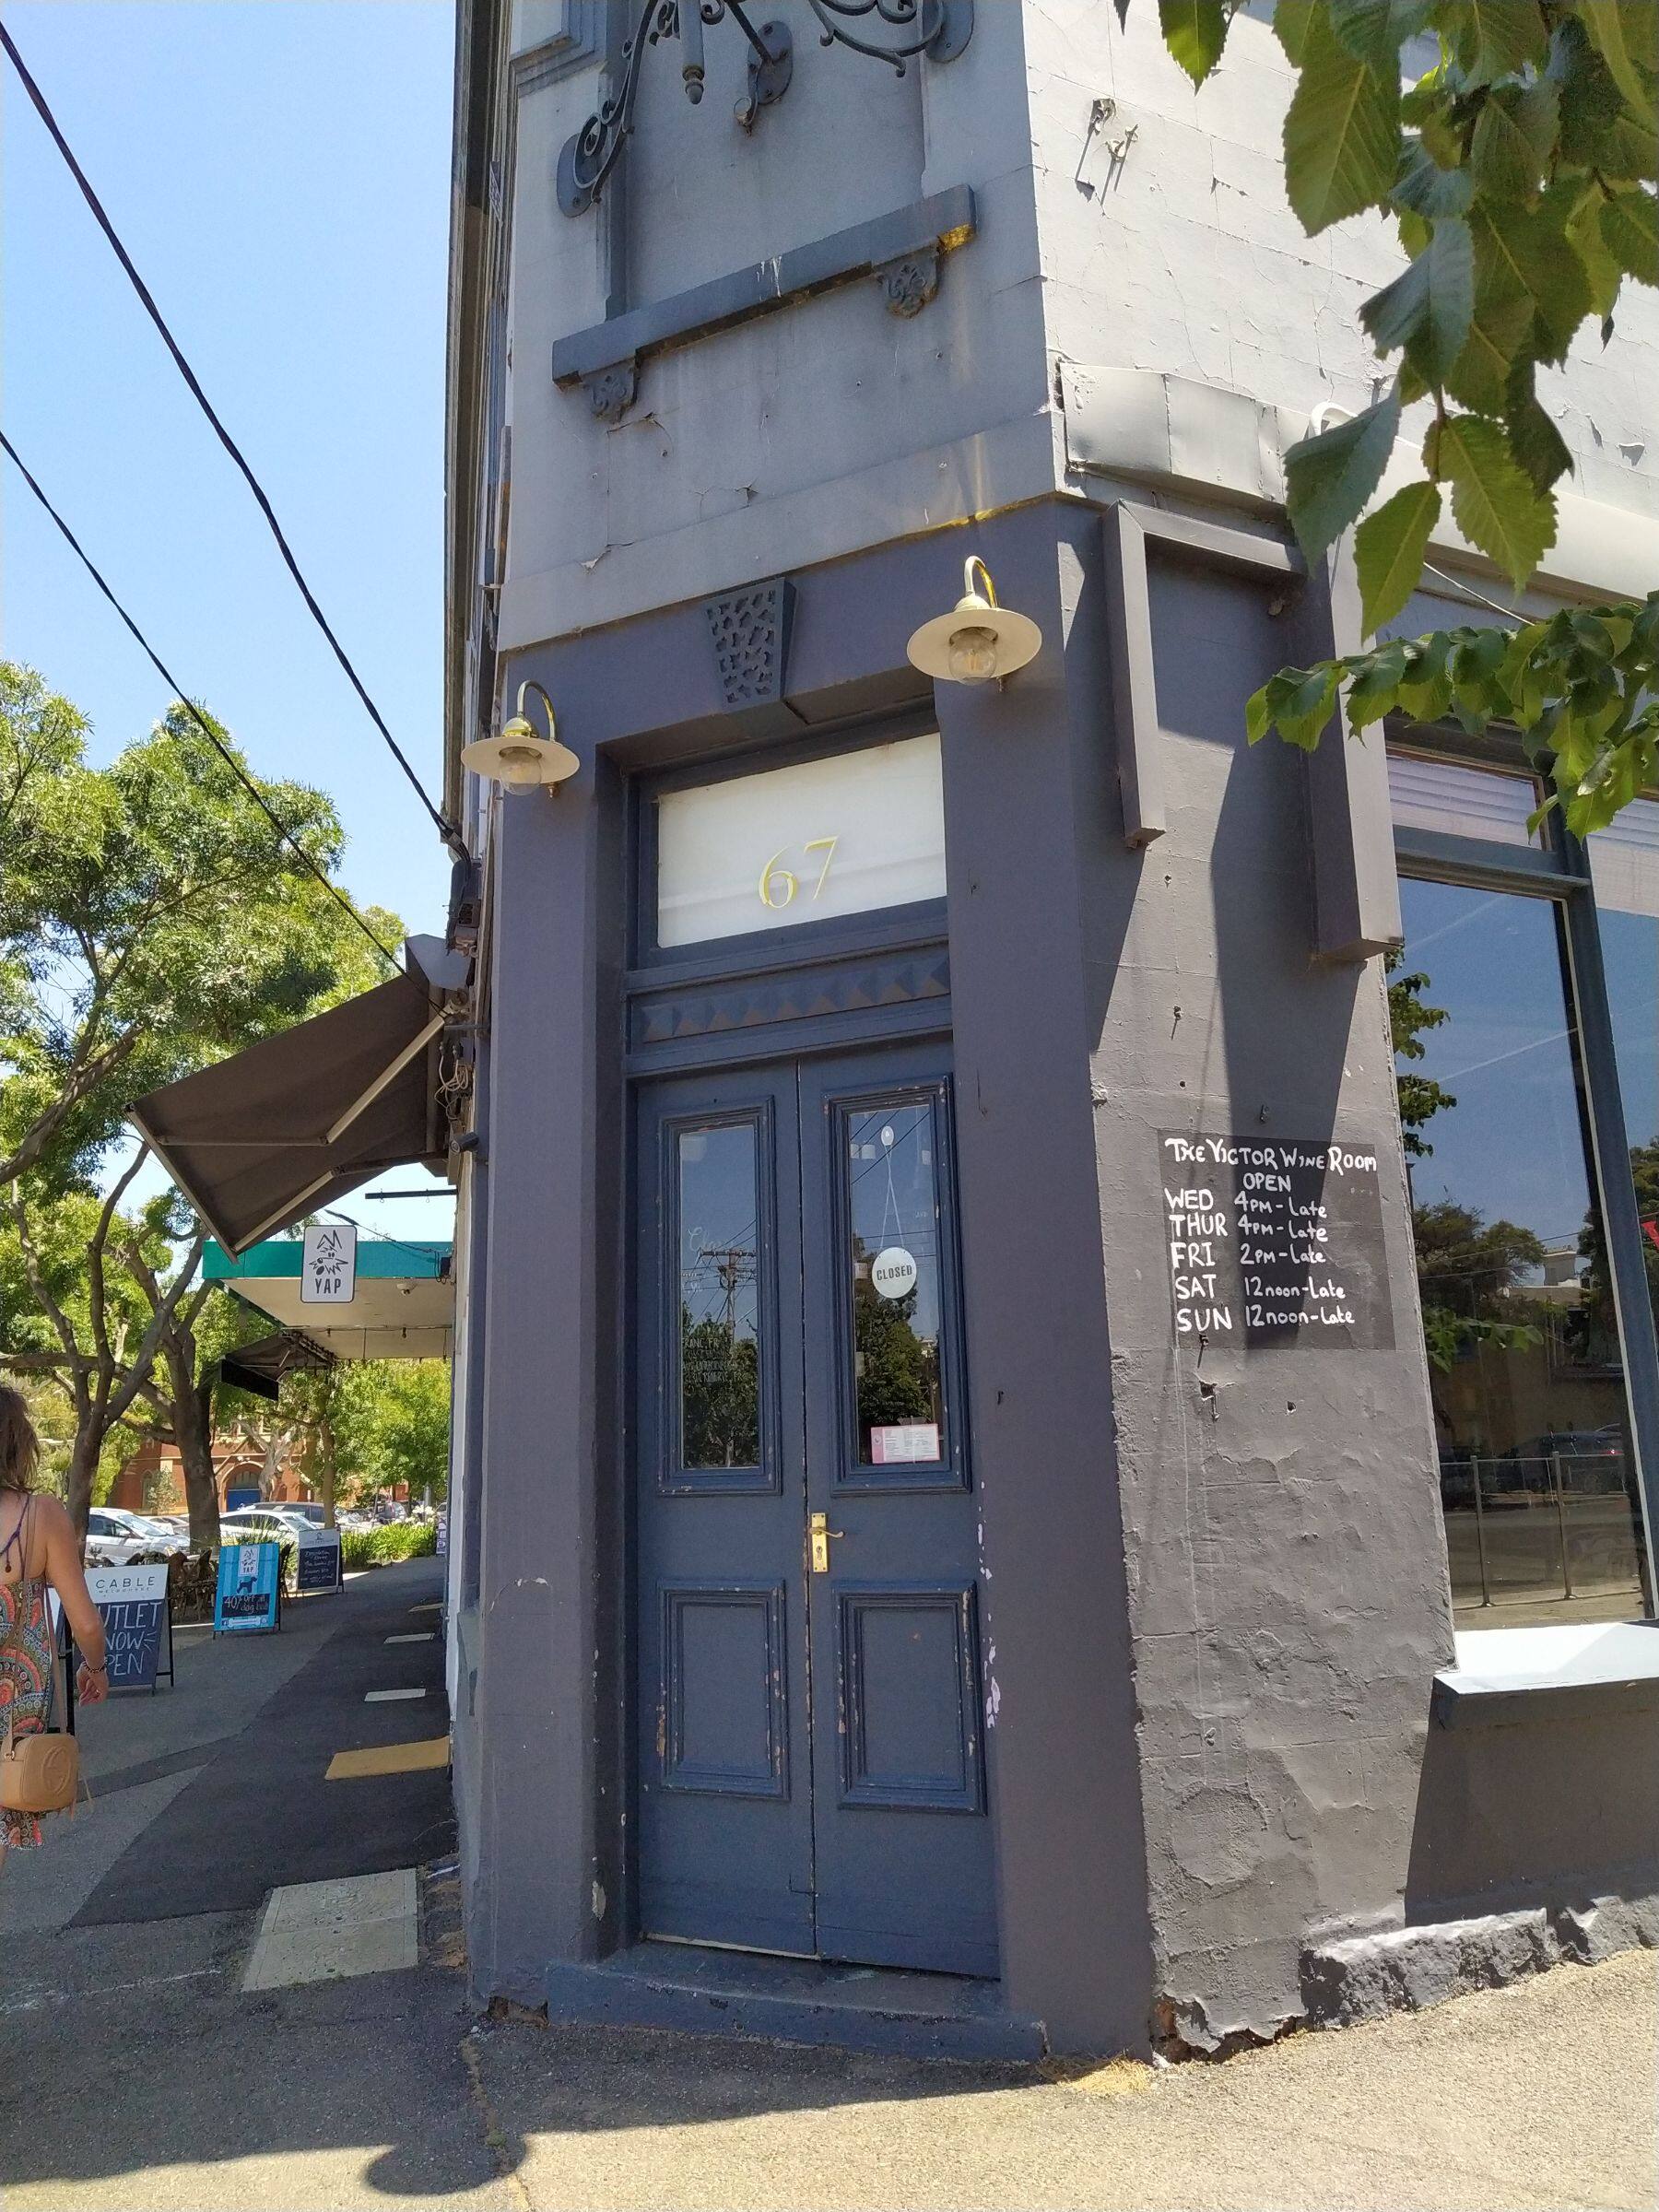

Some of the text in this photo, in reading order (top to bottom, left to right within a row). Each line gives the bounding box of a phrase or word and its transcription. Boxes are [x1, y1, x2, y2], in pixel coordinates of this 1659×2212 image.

[758, 833, 841, 909] 67
[1243, 1172, 1291, 1192] OPEN
[1164, 1187, 1214, 1210] WED
[1169, 1213, 1229, 1237] THUR
[1170, 1241, 1216, 1269] FRI
[877, 1265, 912, 1281] CLOSED
[315, 1277, 341, 1294] YAP
[1174, 1274, 1217, 1300] SAT
[1176, 1307, 1232, 1332] SUN
[96, 1576, 155, 1589] CABLE
[98, 1602, 161, 1630] UTLET
[106, 1652, 144, 1676] PEN
